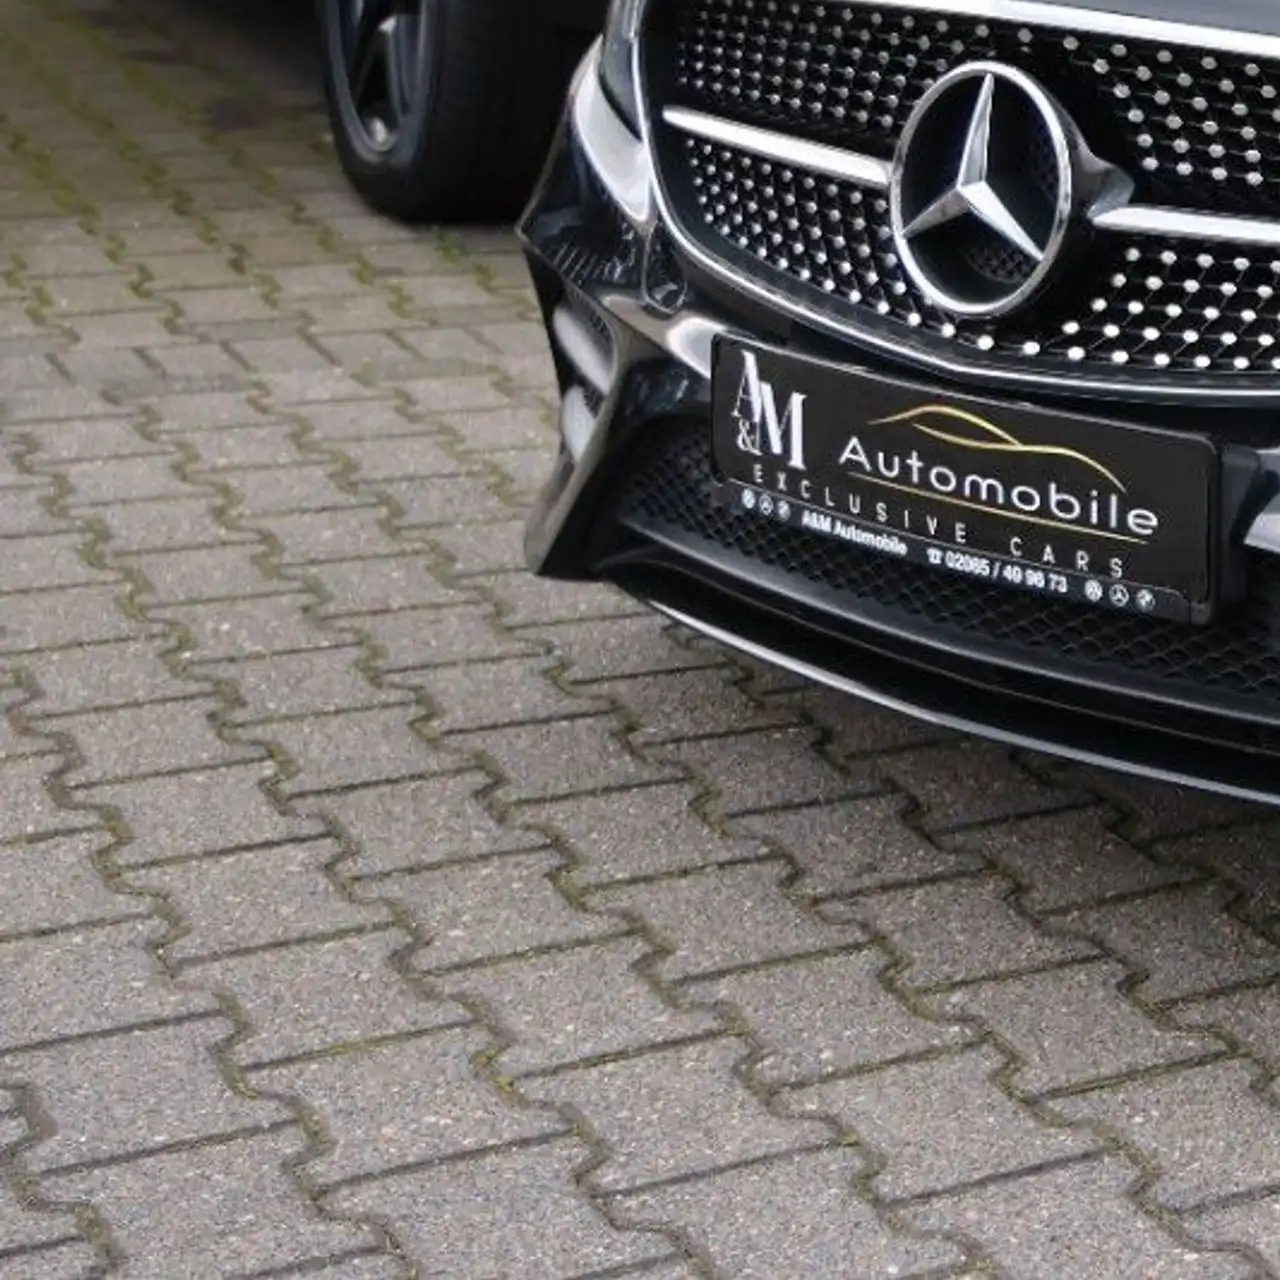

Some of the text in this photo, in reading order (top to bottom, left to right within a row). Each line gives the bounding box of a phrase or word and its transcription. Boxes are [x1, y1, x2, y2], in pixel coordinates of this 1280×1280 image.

[753, 462, 1123, 580] EXCLUSIVE CARS
[838, 435, 1159, 537] Automobile
[832, 520, 908, 557] Automobile
